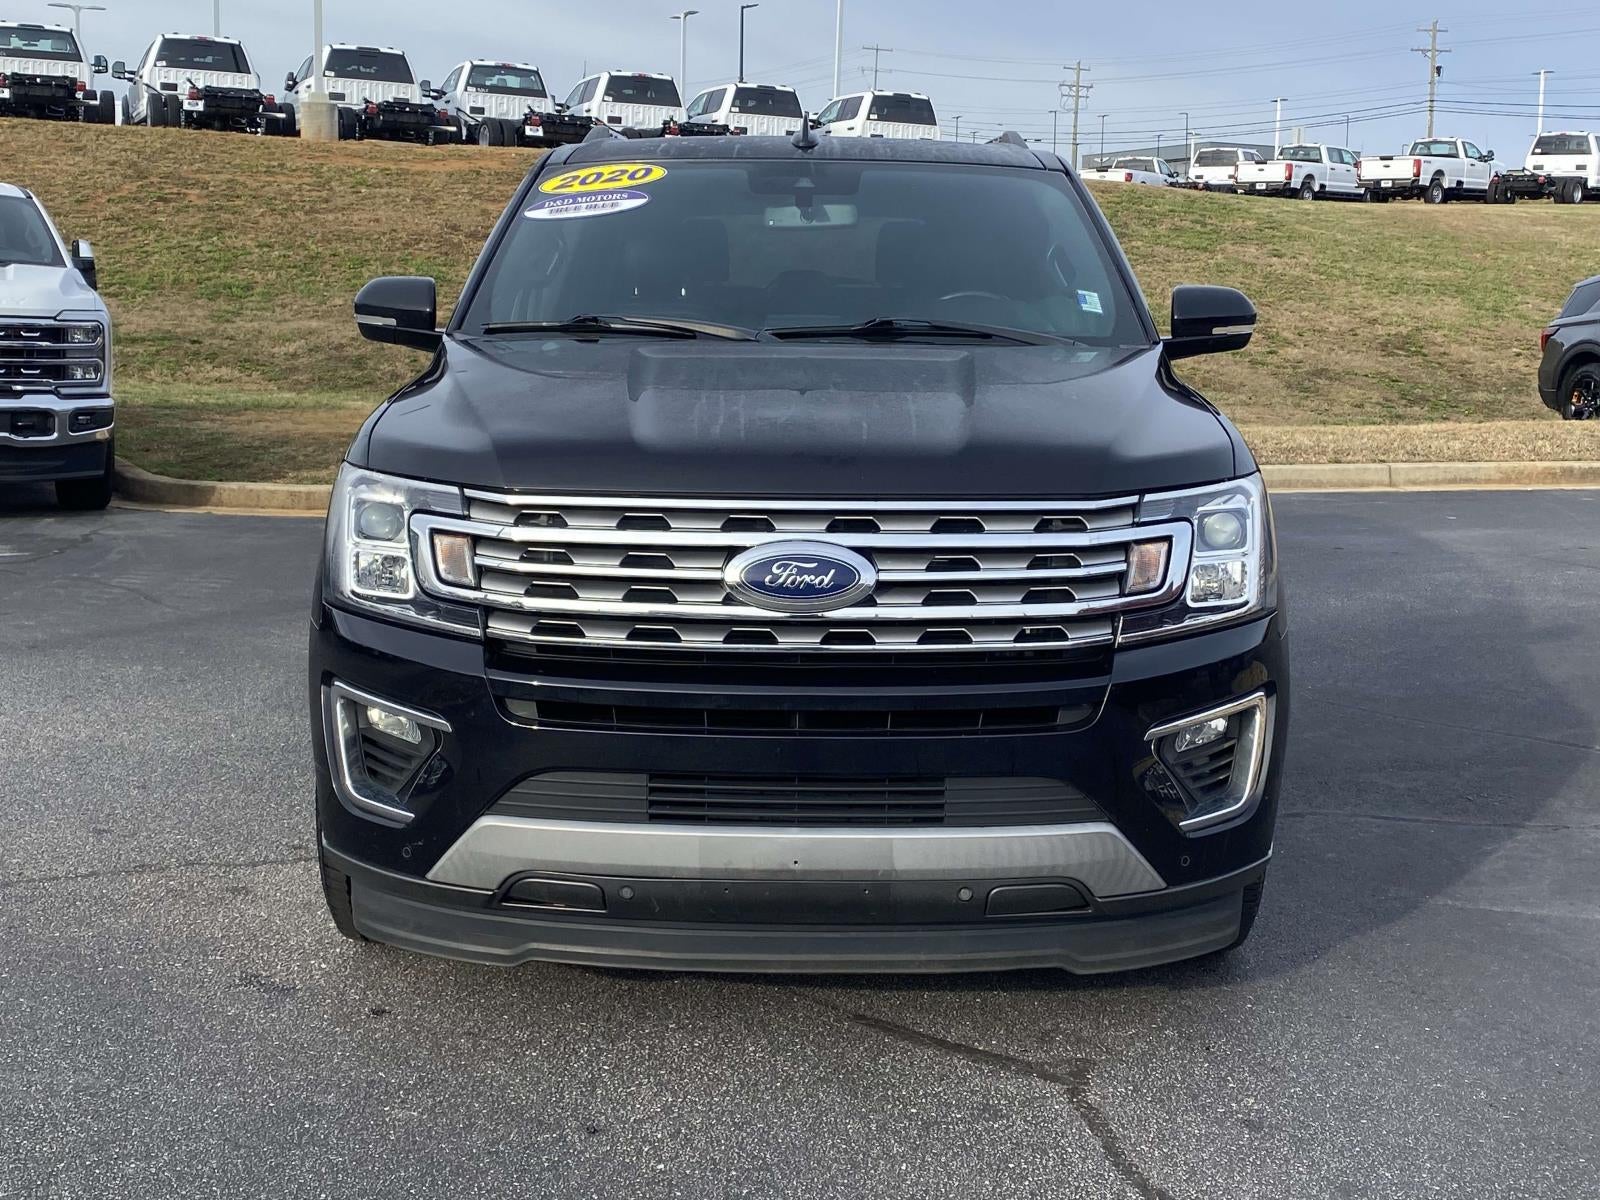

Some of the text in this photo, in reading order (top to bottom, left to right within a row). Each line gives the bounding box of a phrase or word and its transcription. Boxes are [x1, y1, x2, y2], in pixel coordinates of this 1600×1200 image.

[552, 167, 653, 190] 2020
[544, 192, 629, 208] D&D MOTORS
[764, 560, 836, 590] Ford
